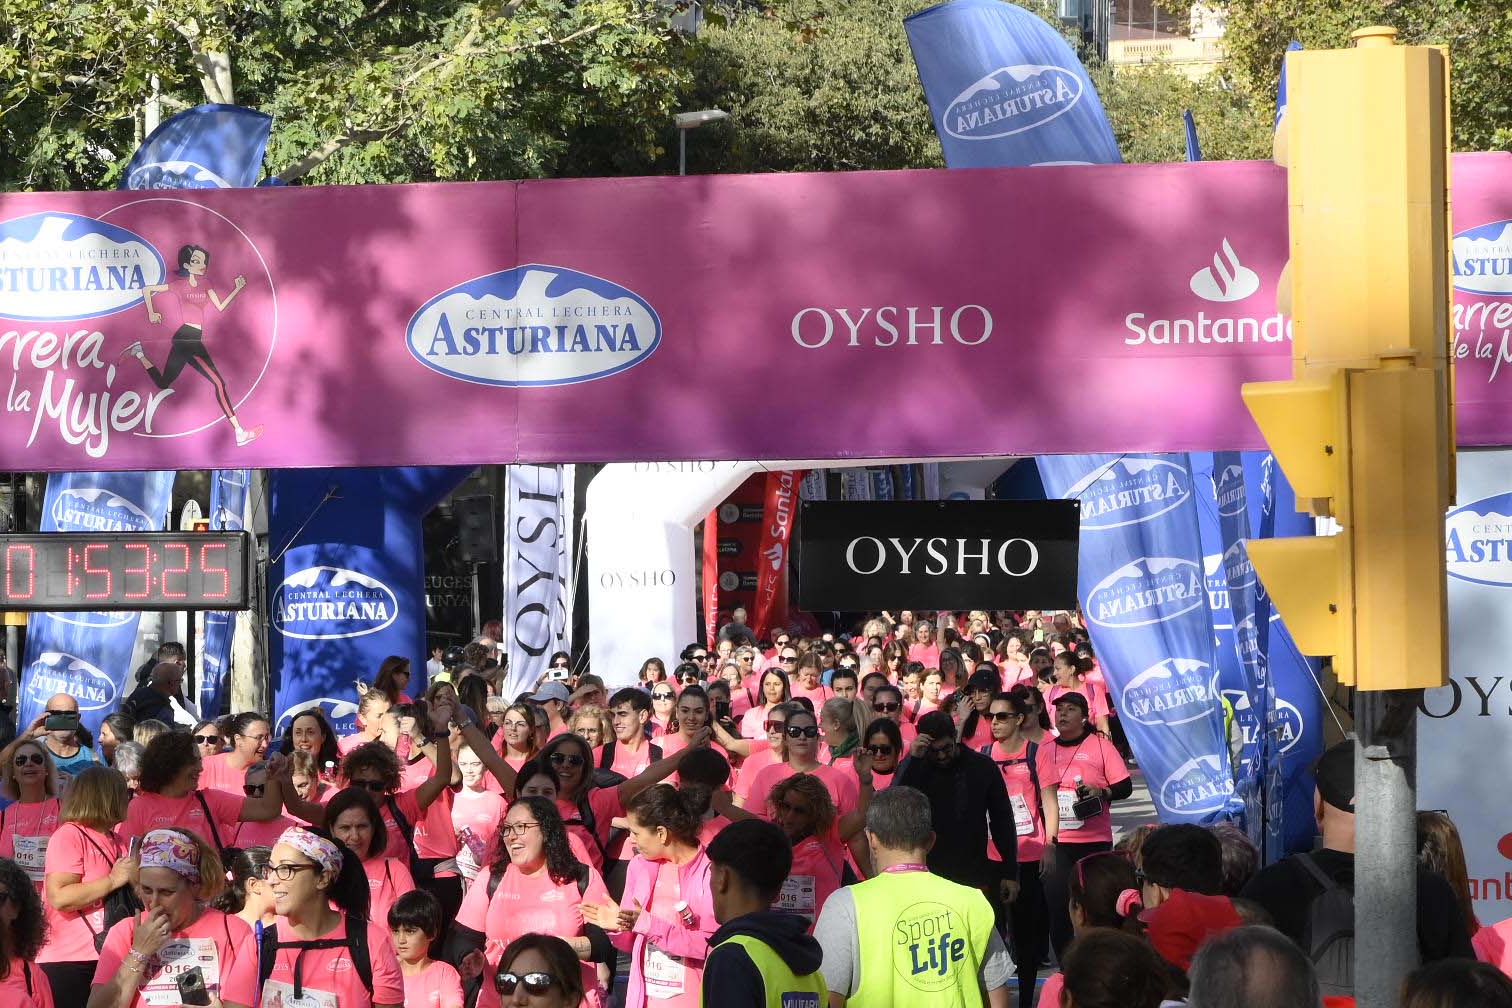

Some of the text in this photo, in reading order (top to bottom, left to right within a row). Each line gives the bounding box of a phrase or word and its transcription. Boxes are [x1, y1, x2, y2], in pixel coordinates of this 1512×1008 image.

[465, 305, 633, 321] CENTRAL LECHERA
[790, 304, 994, 349] OYSHO
[425, 313, 643, 357] ASTURIANA
[1475, 331, 1493, 359] la
[6, 373, 31, 413] la
[26, 367, 176, 458] Mujer
[846, 535, 1039, 577] OYSHO
[276, 596, 389, 622] ASTURIANA
[288, 590, 331, 600] CENTRAL
[16, 852, 34, 861] 016
[896, 909, 954, 946] Sport
[908, 932, 965, 977] Life
